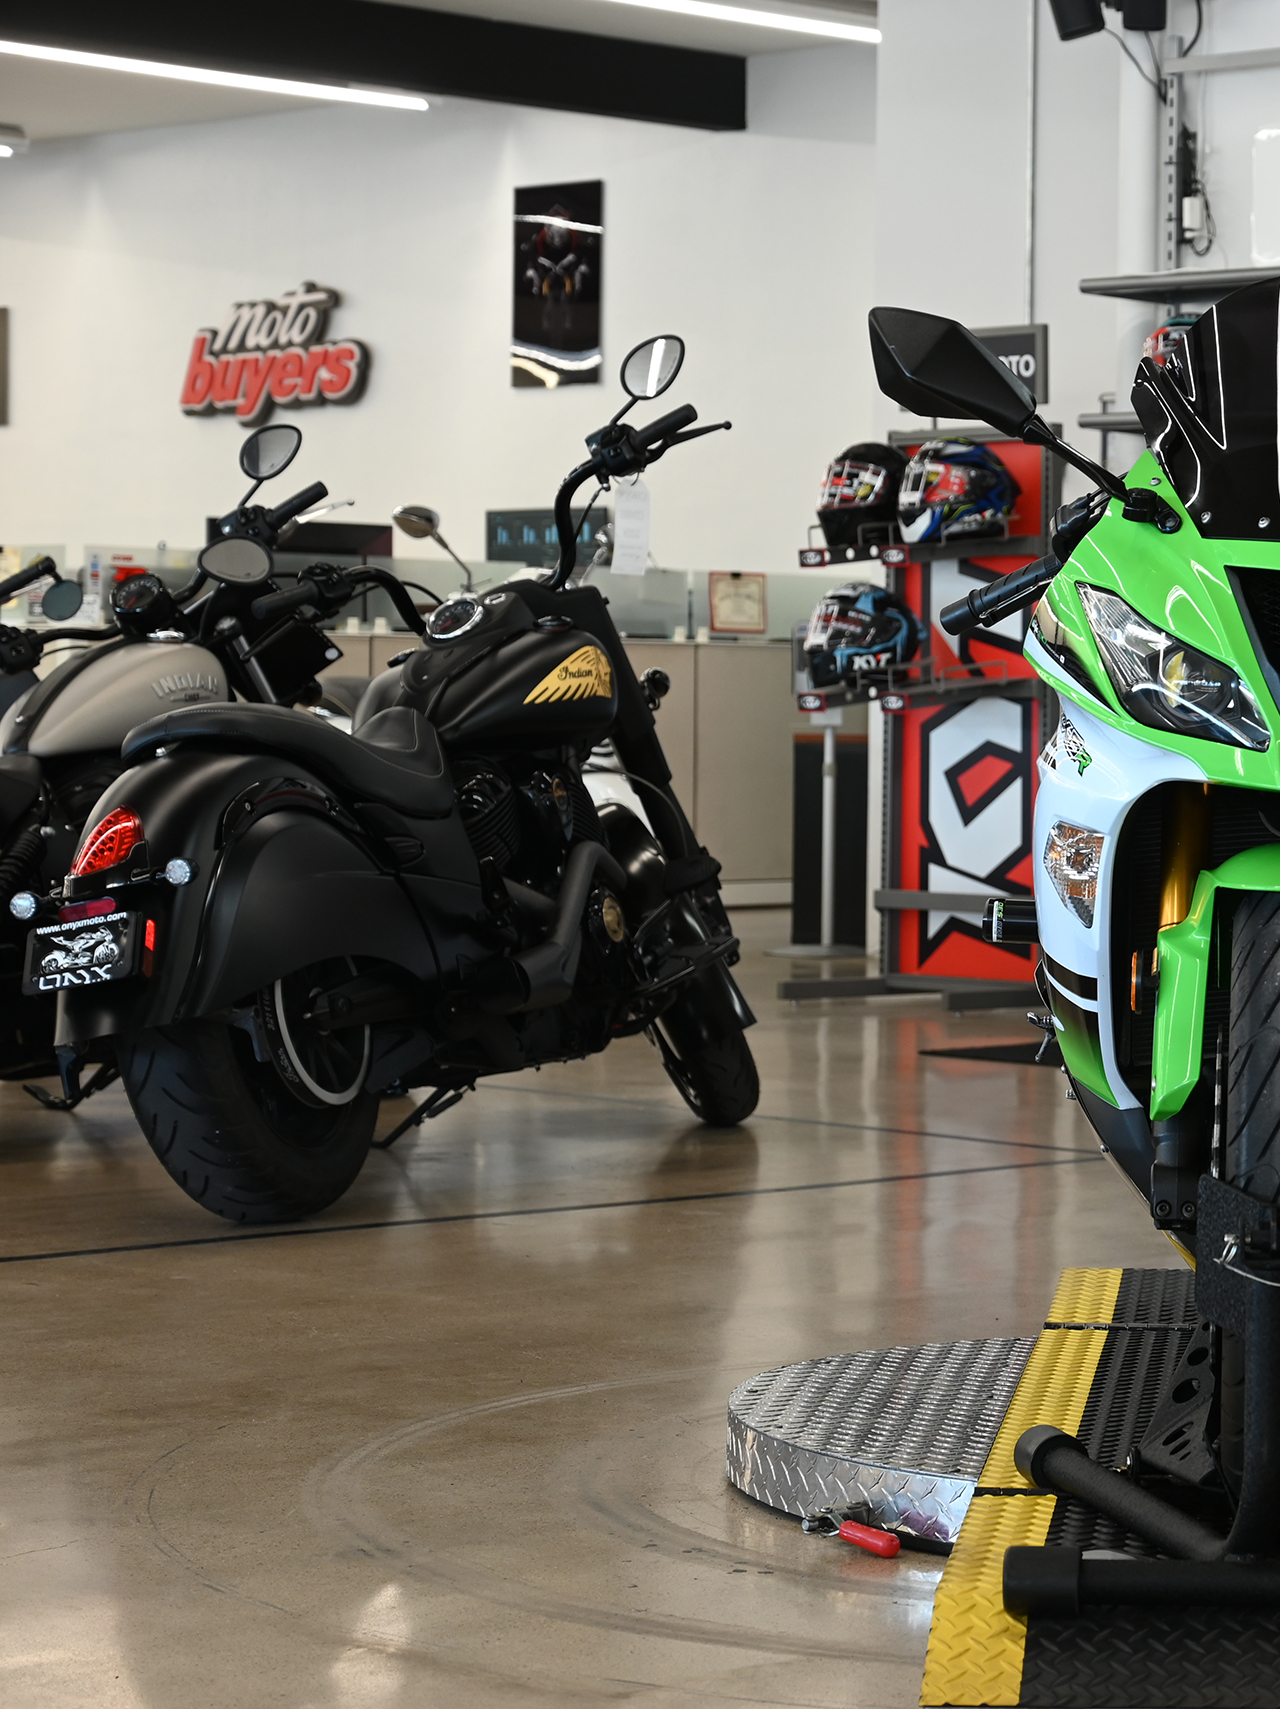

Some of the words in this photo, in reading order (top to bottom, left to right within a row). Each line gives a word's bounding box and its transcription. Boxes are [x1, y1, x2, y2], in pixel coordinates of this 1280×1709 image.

[212, 283, 328, 350] Moto
[180, 334, 357, 418] buyers
[557, 665, 594, 681] Indian
[852, 652, 893, 671] KYT
[37, 912, 127, 935] www.onyxmoto.com
